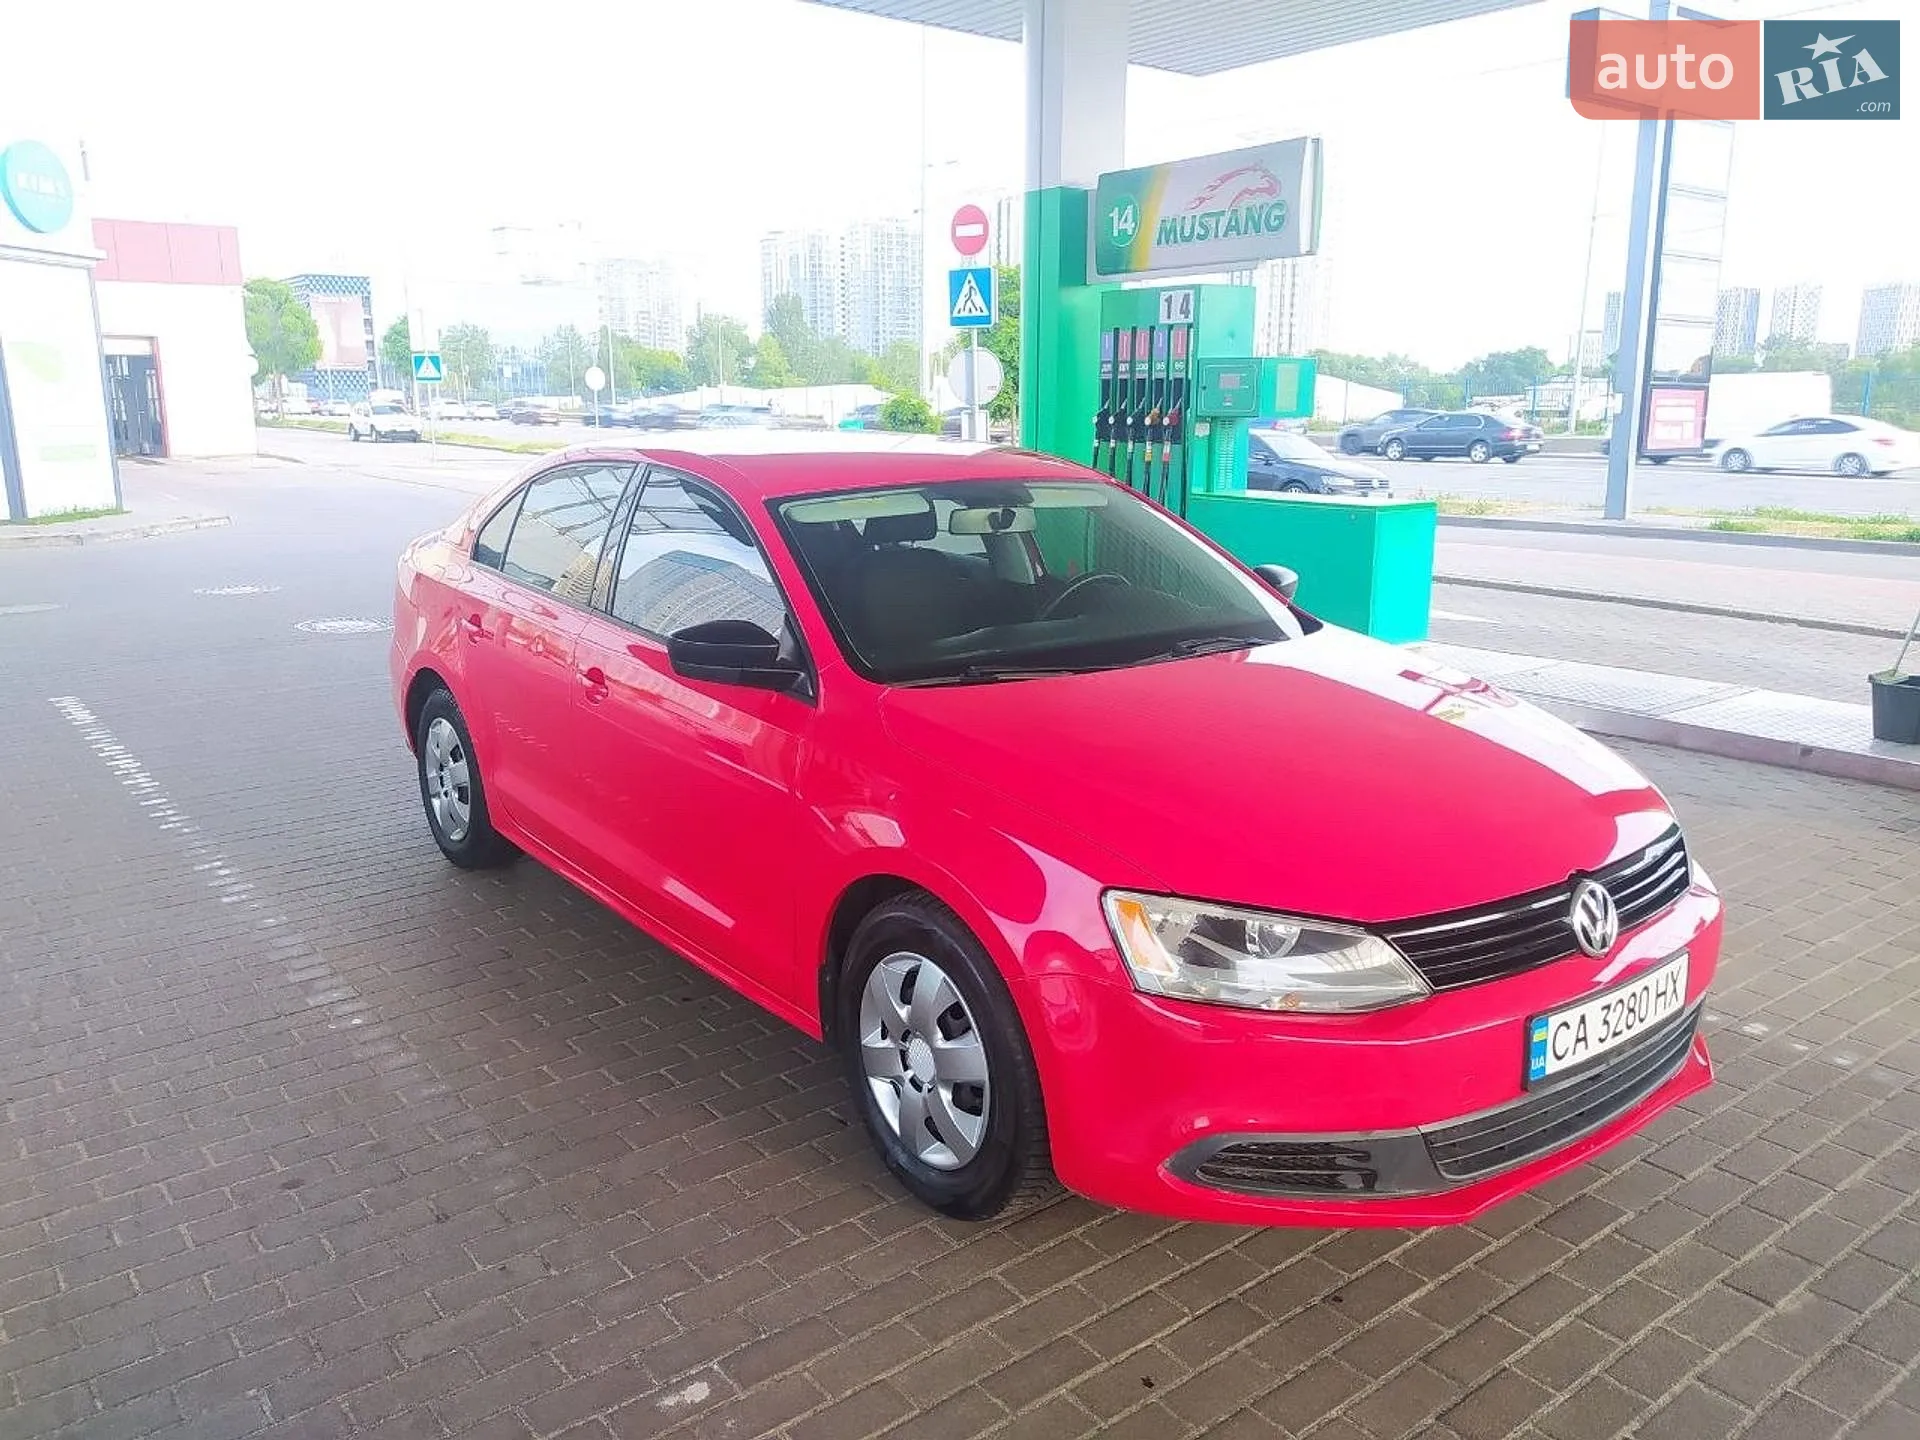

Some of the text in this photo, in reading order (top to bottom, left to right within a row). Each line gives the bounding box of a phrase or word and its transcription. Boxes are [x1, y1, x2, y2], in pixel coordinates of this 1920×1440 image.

[1108, 203, 1136, 238] 14
[1156, 201, 1287, 248] MUSTANG
[1164, 293, 1192, 320] 14
[1552, 965, 1682, 1062] CA 3280 HX
[1530, 1056, 1545, 1070] UA
